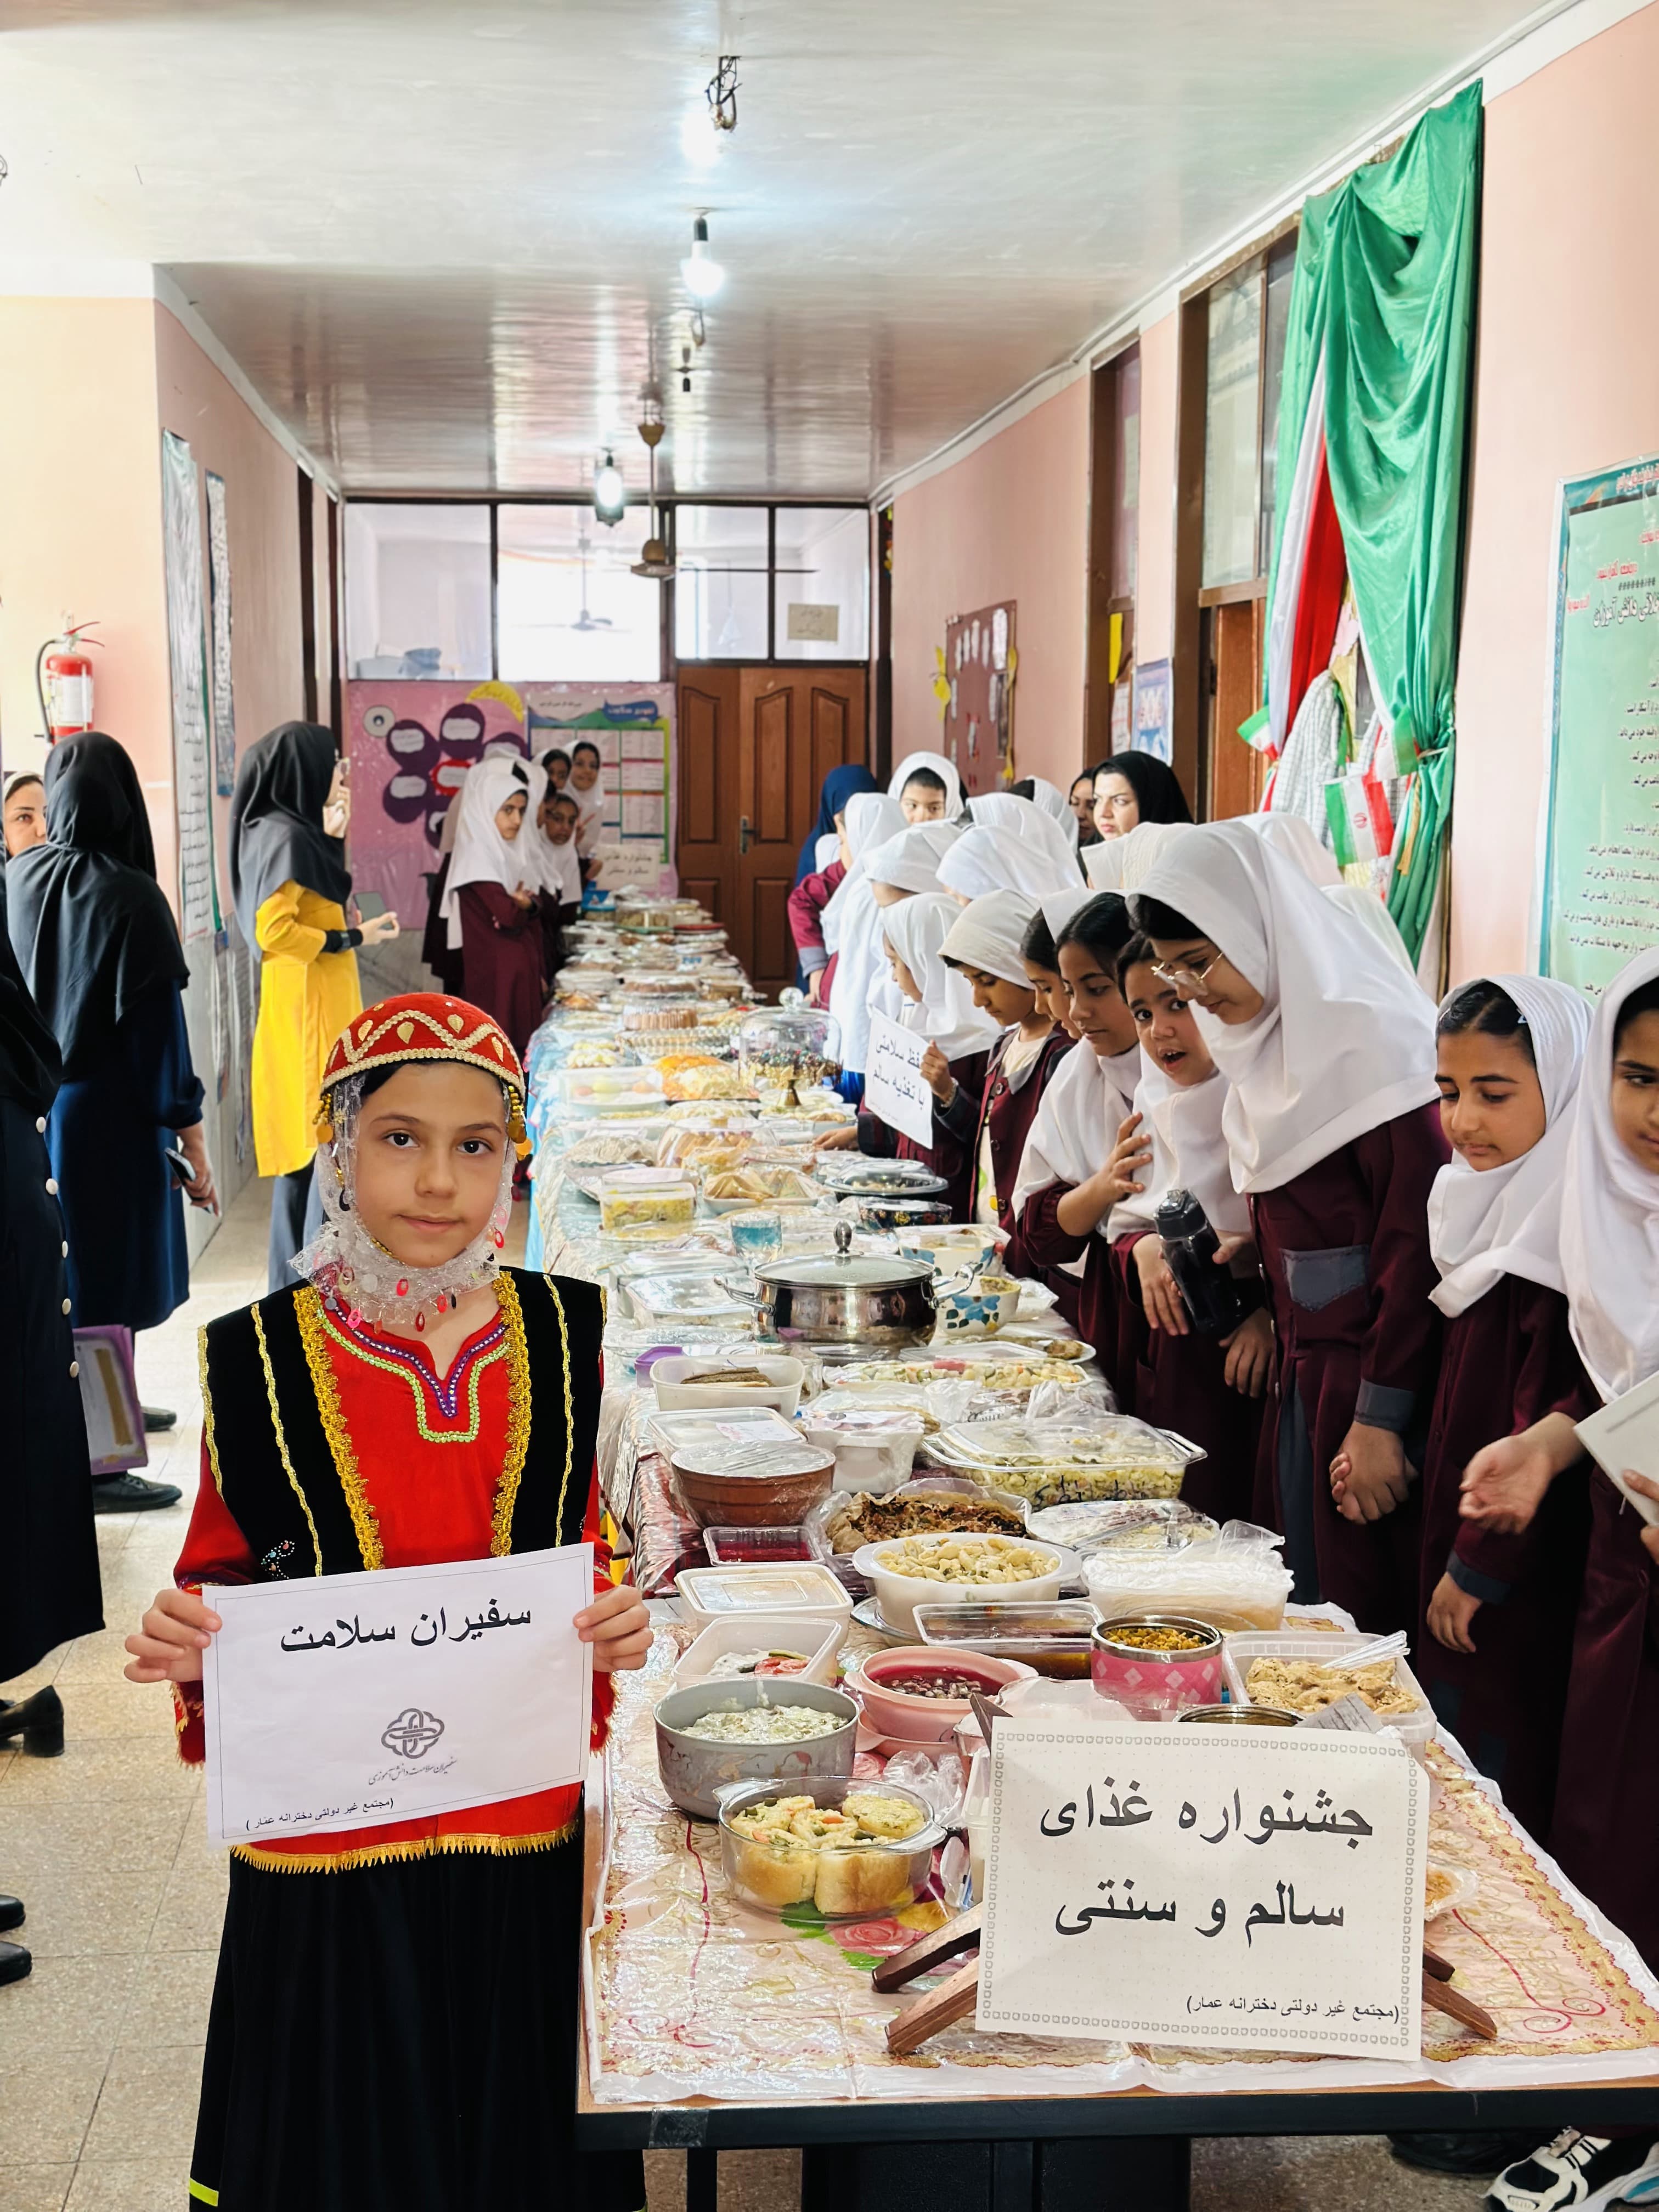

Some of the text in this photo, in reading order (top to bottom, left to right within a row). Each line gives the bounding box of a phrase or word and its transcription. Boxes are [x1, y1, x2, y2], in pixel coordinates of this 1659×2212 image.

[280, 1598, 532, 1652] سفیران سلامت
[279, 1812, 312, 1822] دخترانه
[315, 1808, 340, 1821] دولتی
[343, 1802, 358, 1814] غیر
[1040, 1776, 1373, 1850] جشنواره غذای
[1055, 1878, 1344, 1948] سالم و سنتی
[1187, 1995, 1399, 2024] (مجتمع غیر دولتی دخترانه عمار)
